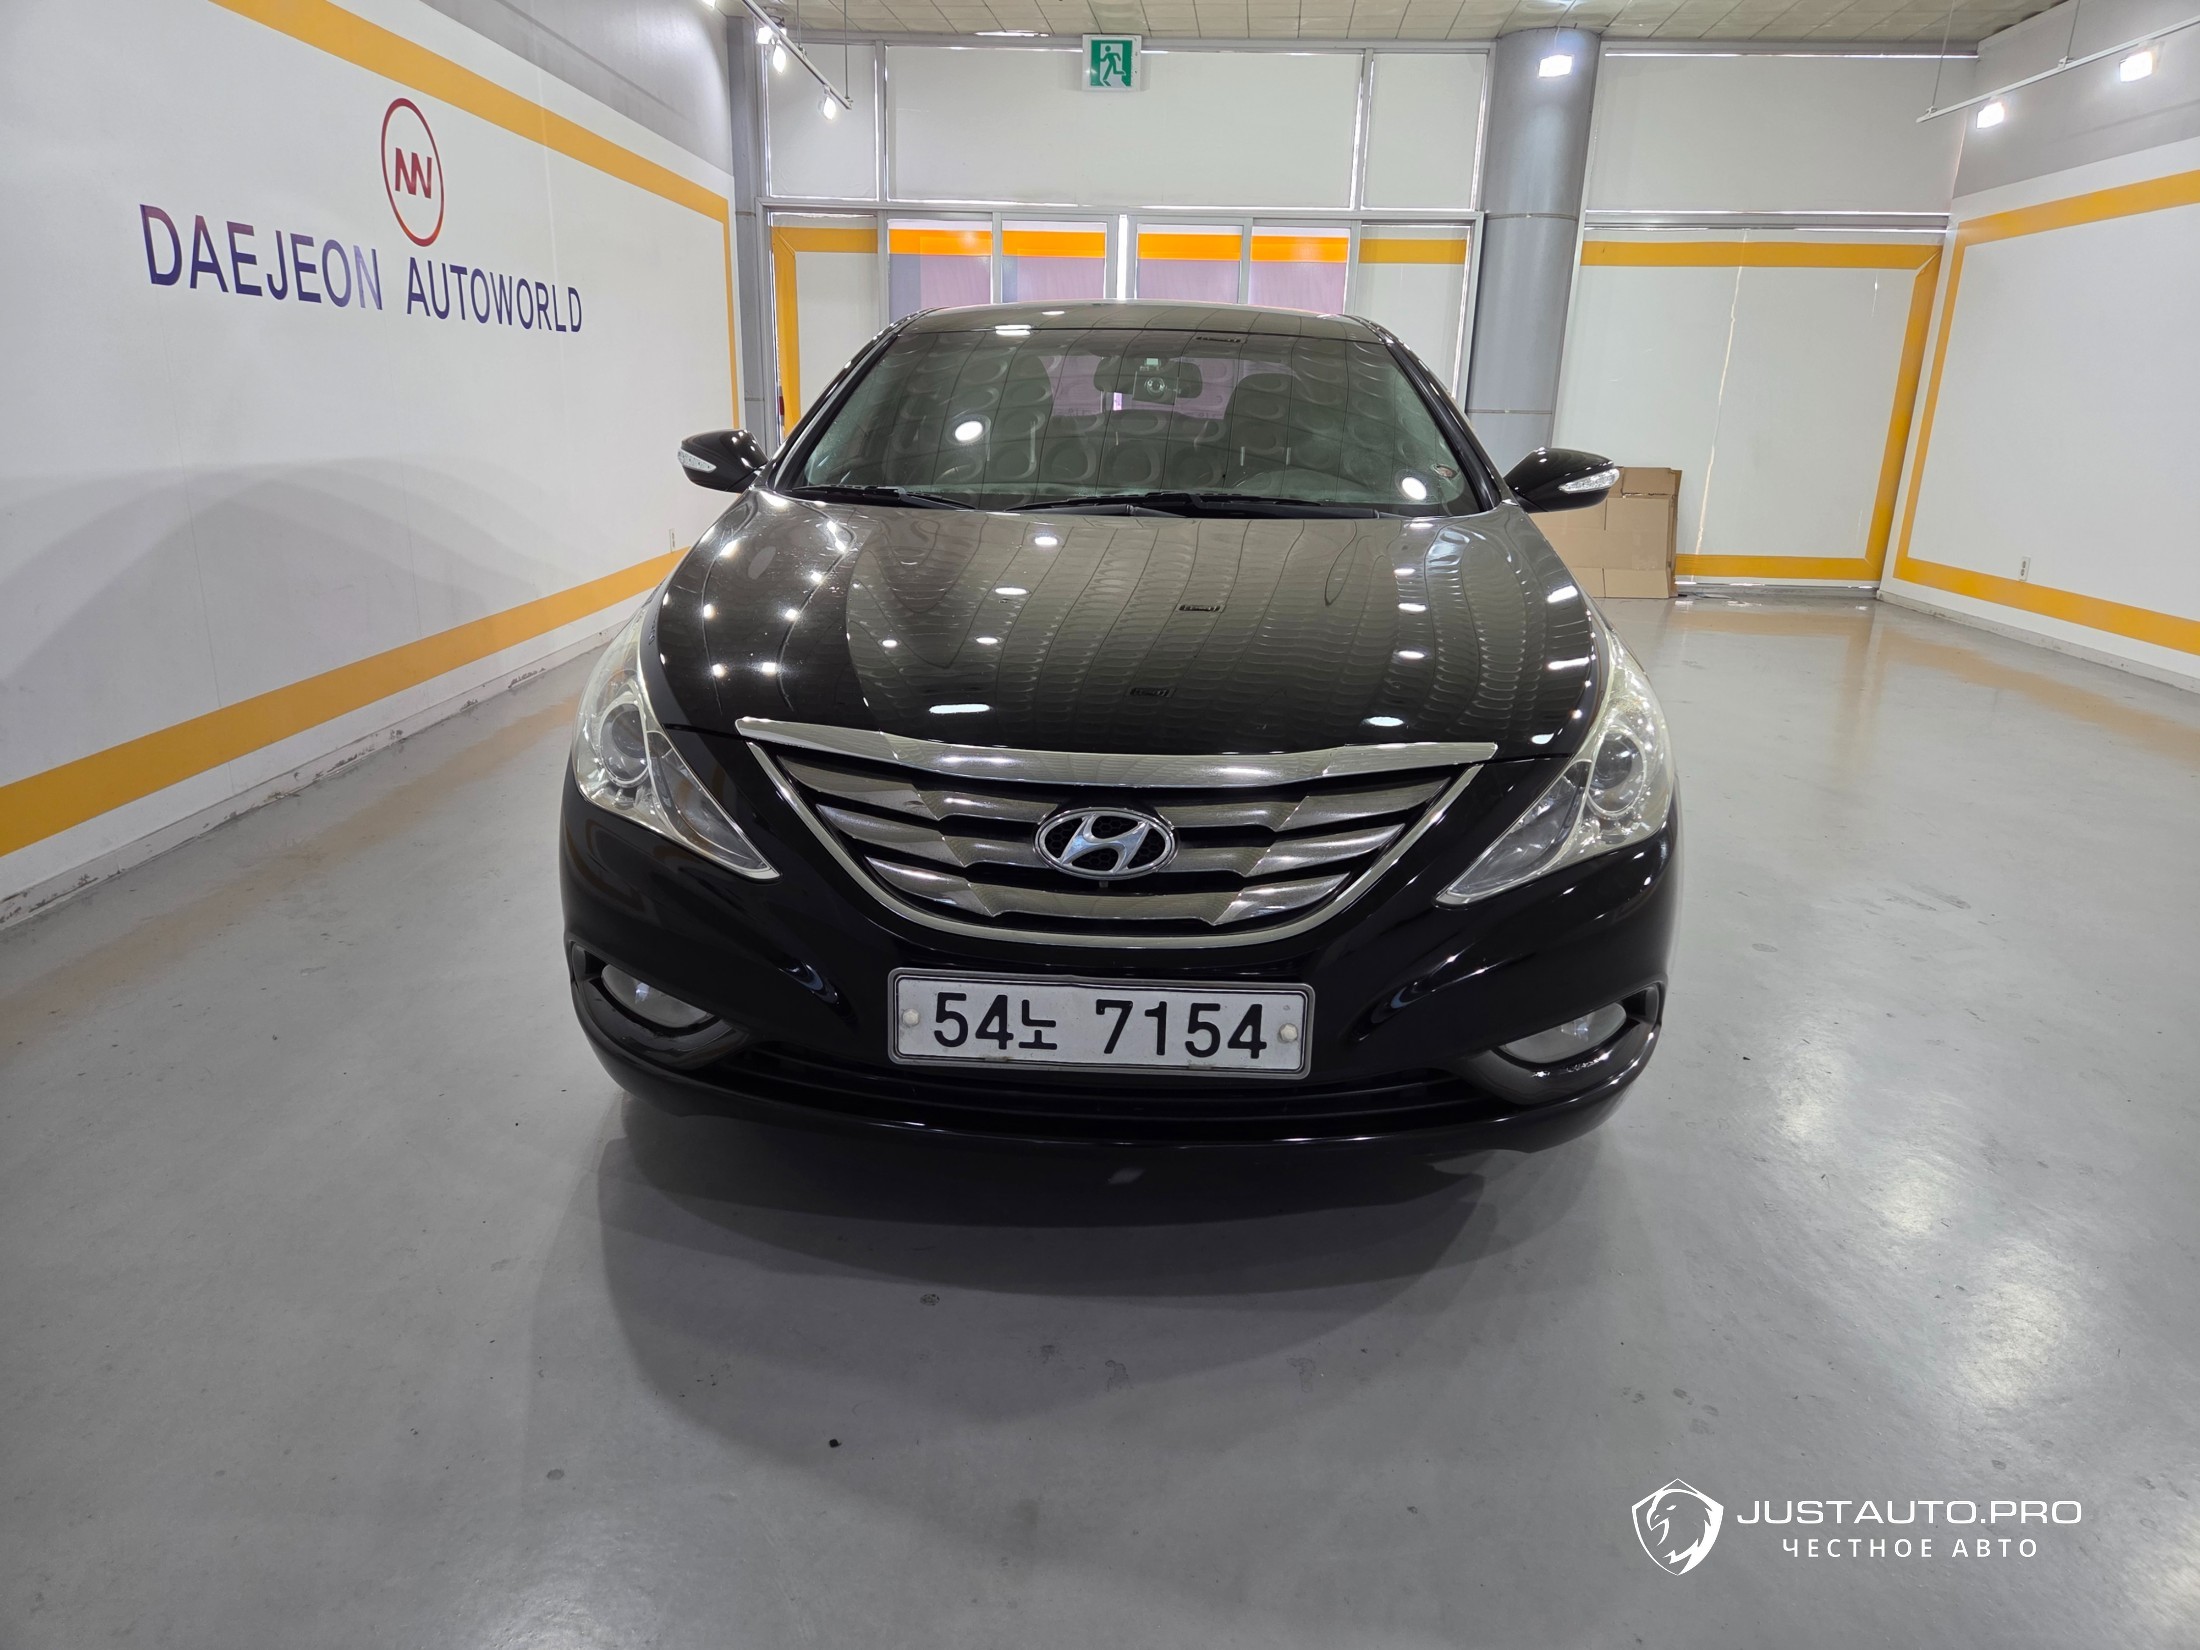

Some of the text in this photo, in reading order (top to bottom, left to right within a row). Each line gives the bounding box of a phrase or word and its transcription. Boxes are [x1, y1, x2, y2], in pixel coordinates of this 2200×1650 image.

[140, 204, 582, 333] DAEJEON AUTOWORLD
[933, 991, 1268, 1060] 54노 7154
